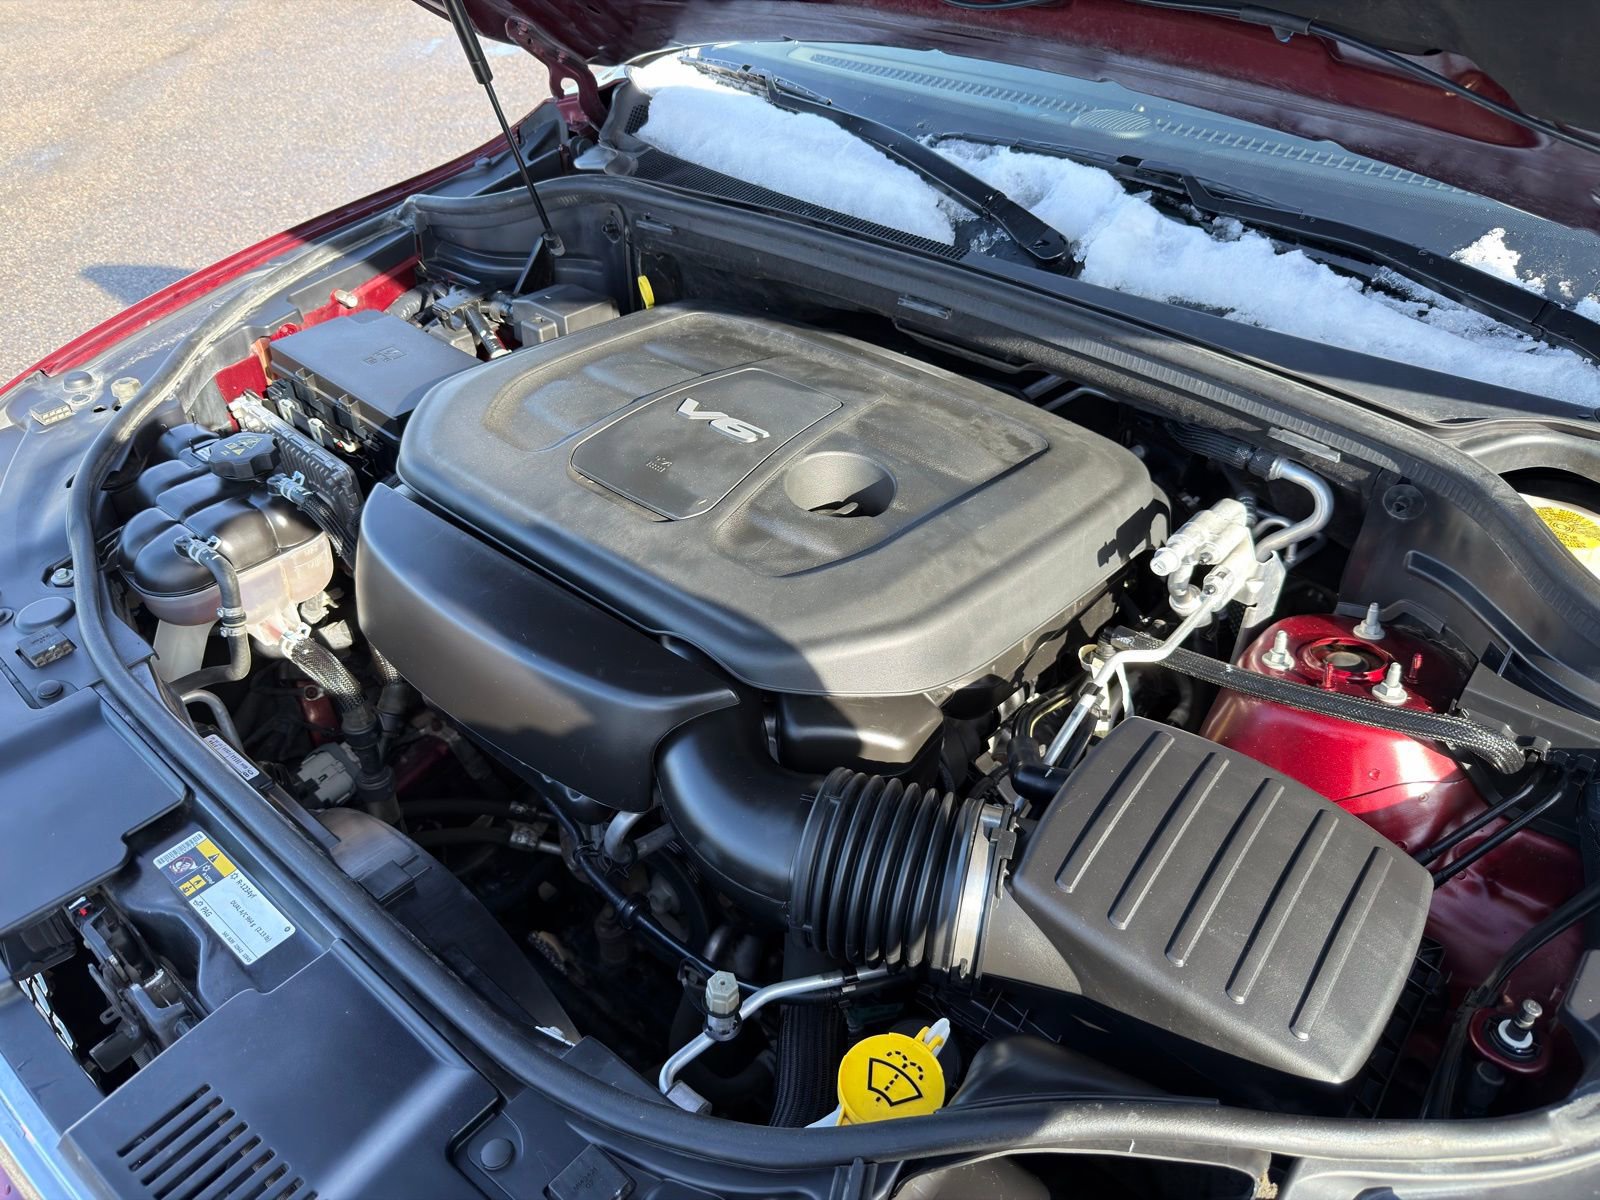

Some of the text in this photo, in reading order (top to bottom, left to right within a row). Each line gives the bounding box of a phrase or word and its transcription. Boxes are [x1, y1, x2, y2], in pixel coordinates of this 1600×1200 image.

[677, 397, 770, 443] V6
[235, 879, 257, 900] R-1234yf
[200, 906, 213, 918] PAG
